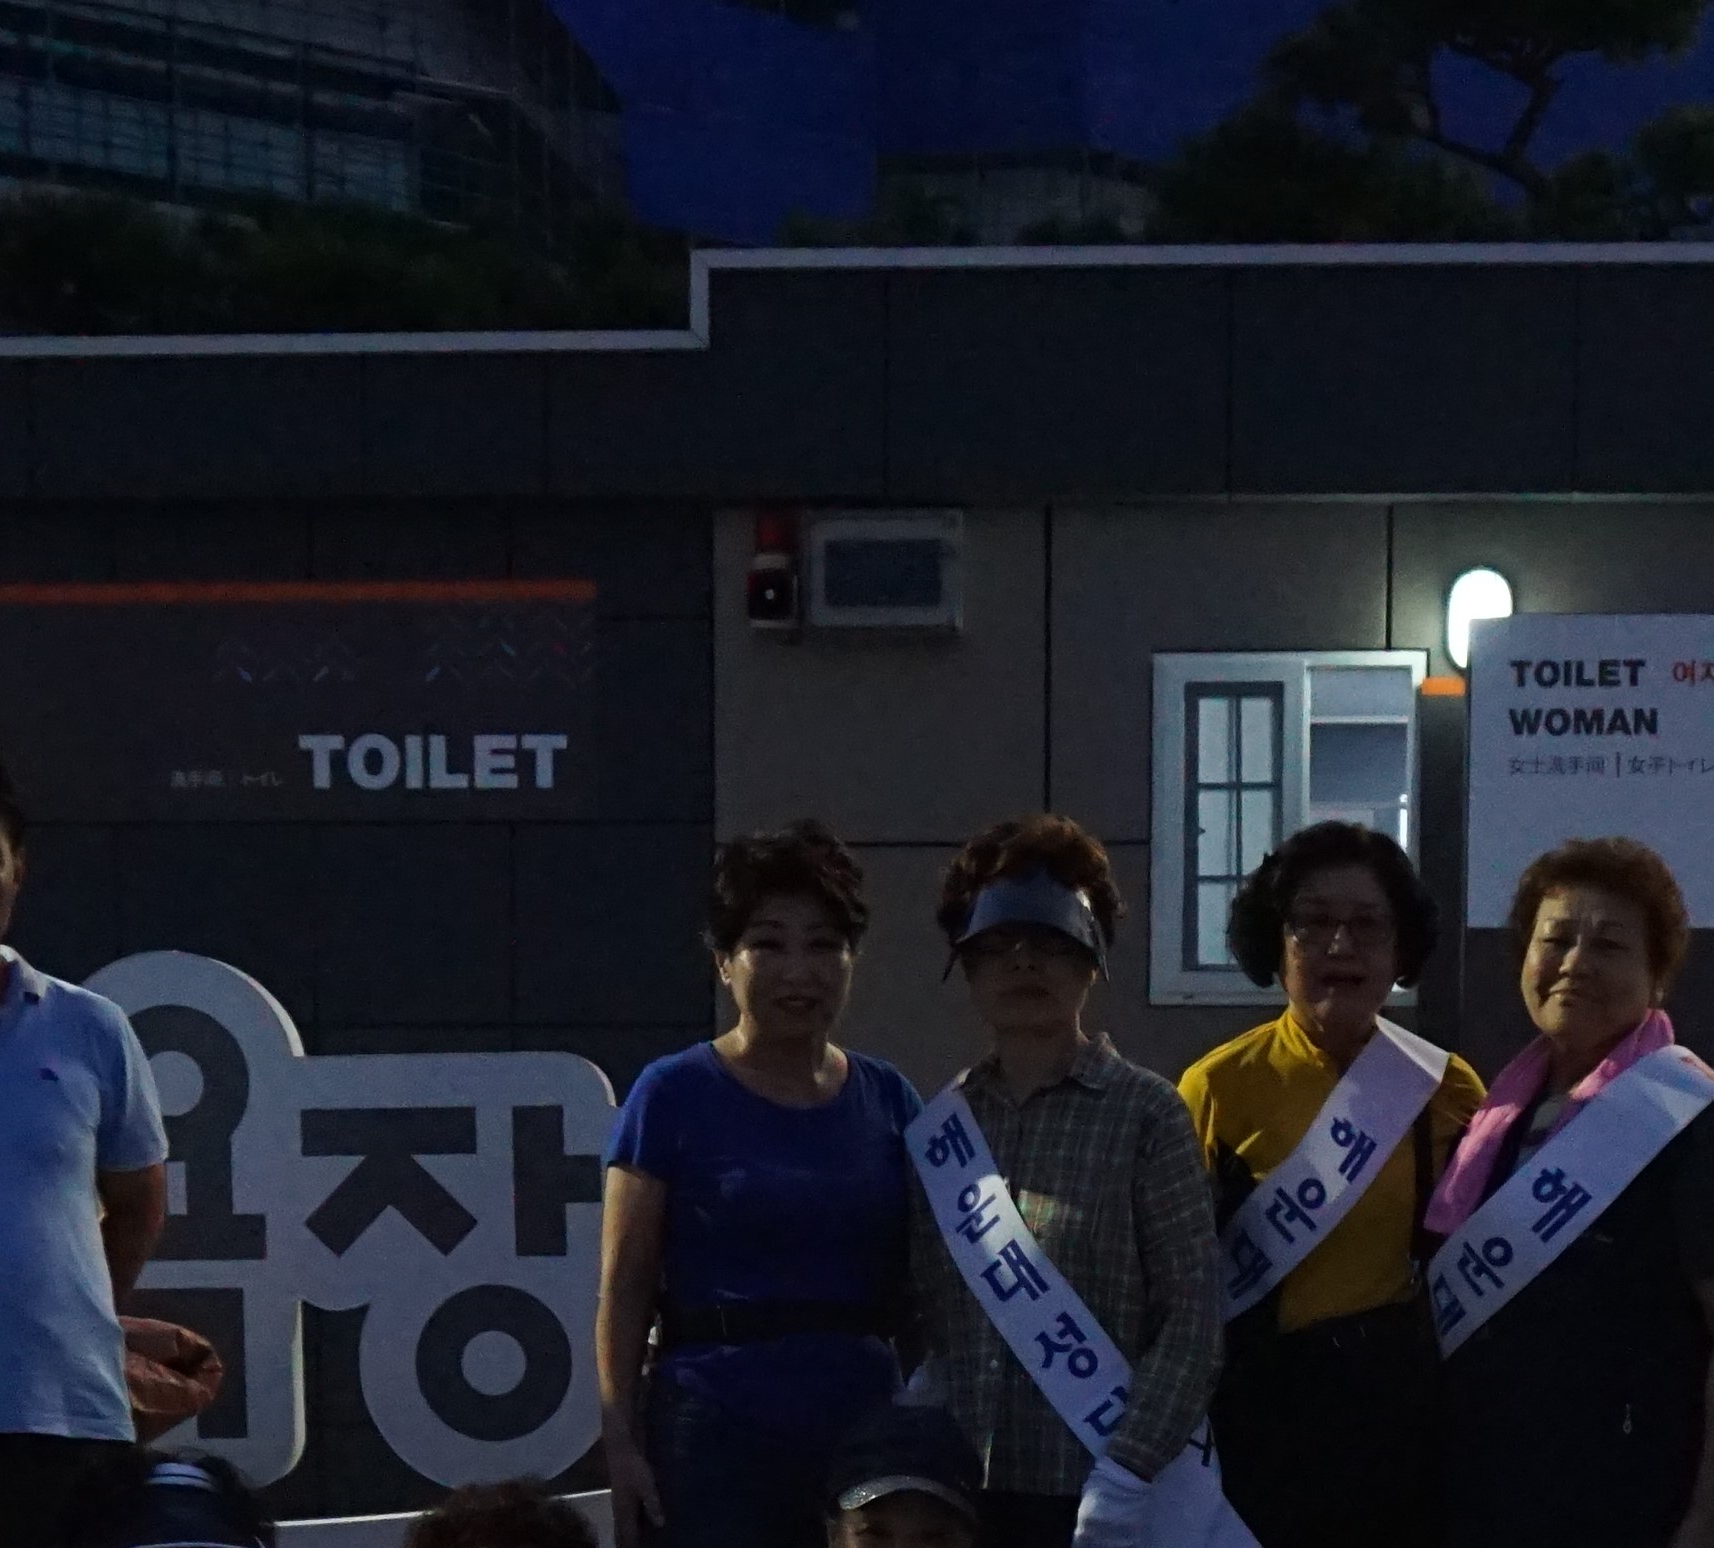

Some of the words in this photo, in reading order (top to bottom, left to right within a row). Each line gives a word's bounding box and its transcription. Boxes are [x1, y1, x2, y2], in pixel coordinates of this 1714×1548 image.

[1510, 659, 1647, 688] TOILET
[1509, 708, 1659, 736] WOMAN
[298, 734, 569, 791] TOILET
